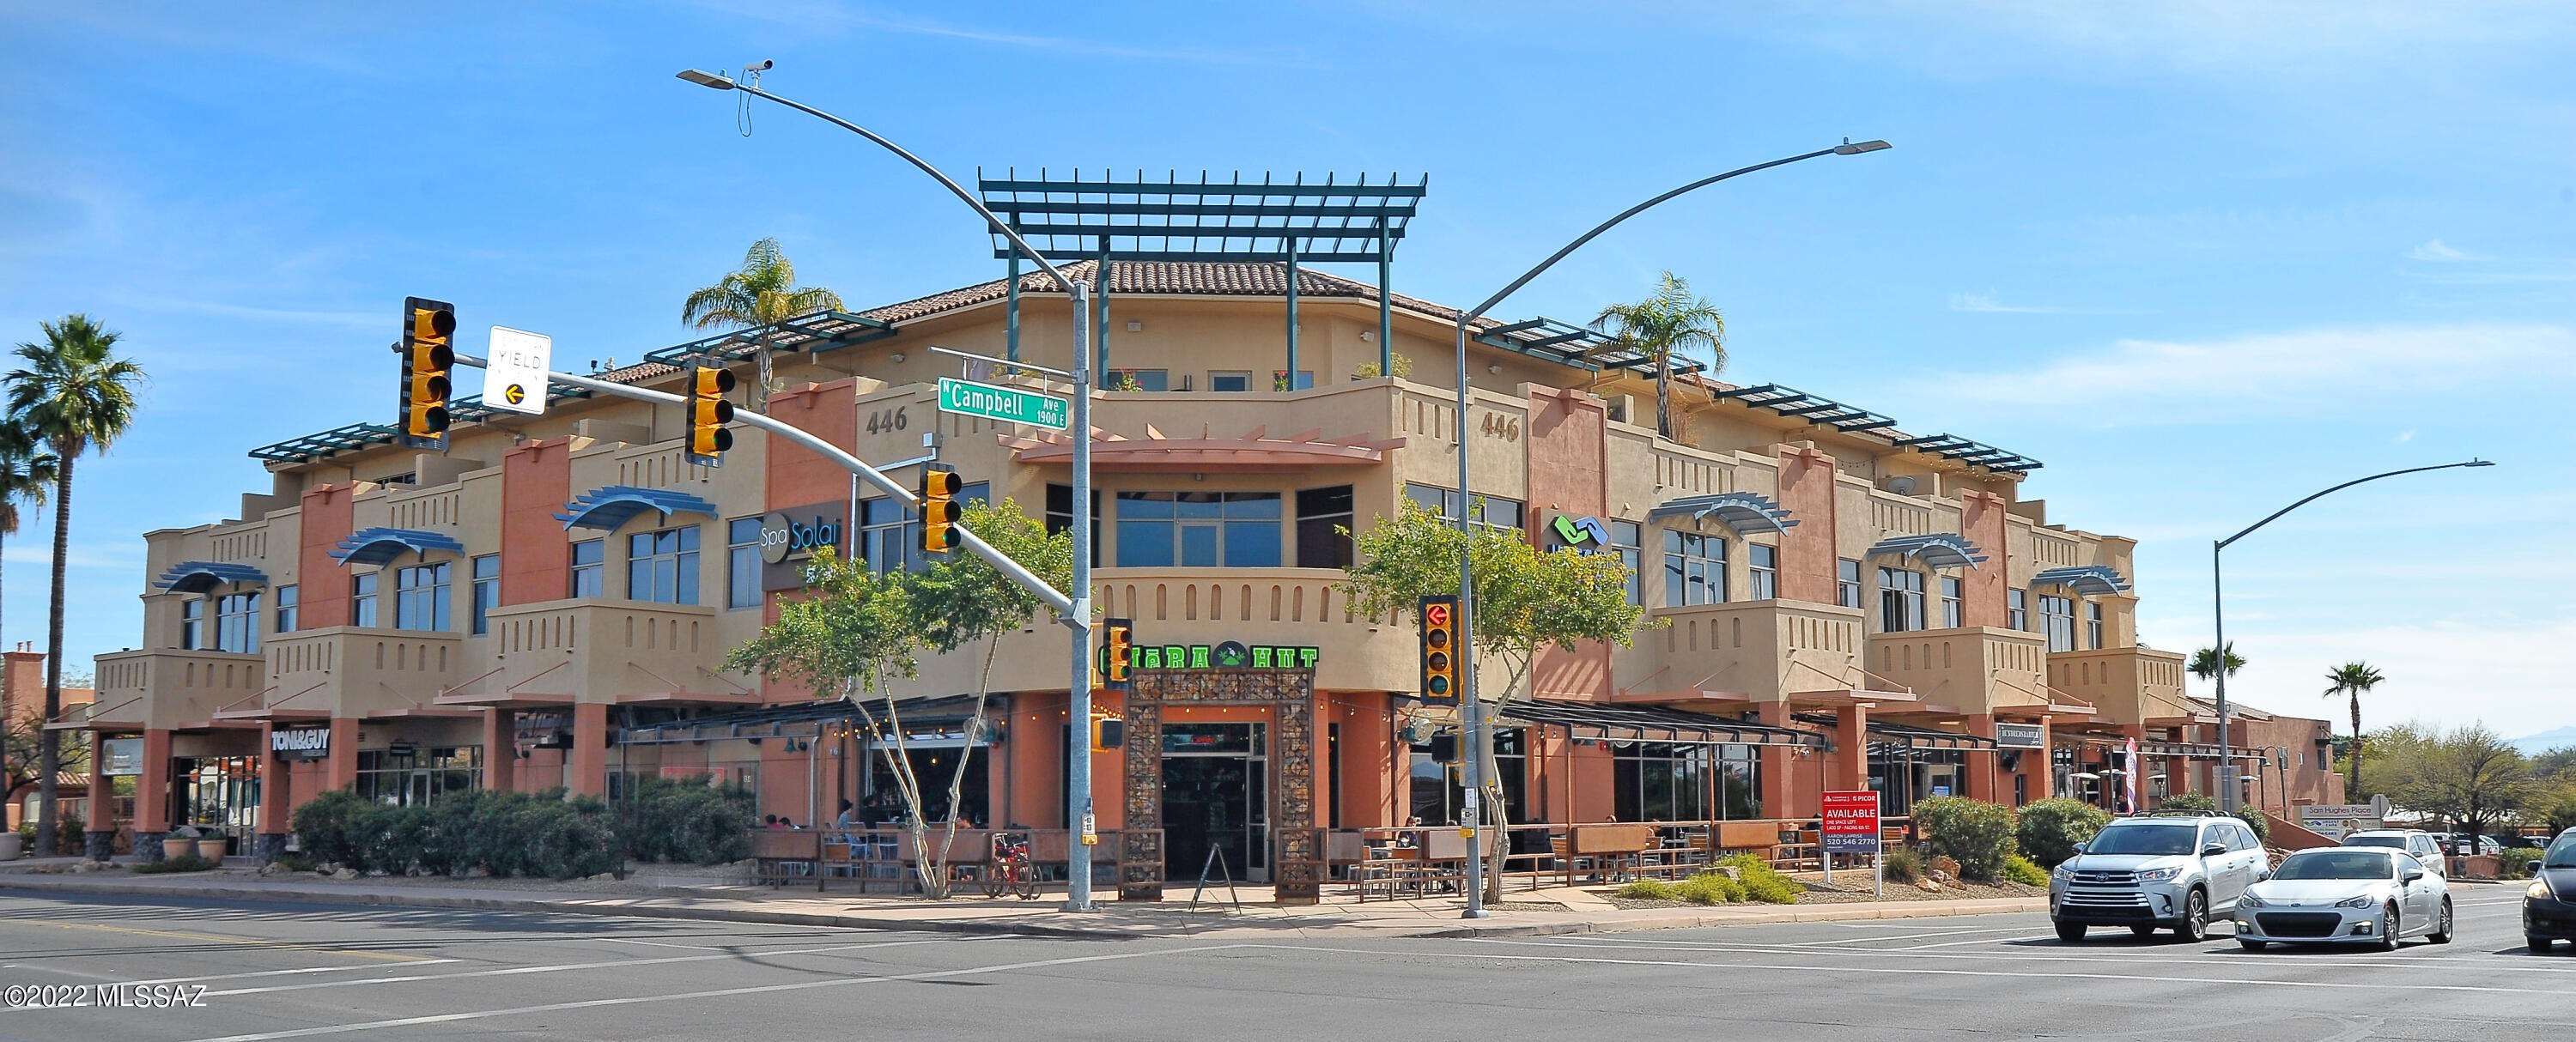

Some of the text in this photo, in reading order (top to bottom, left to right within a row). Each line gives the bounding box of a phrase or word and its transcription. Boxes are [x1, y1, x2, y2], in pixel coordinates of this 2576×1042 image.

[498, 349, 541, 370] YIELD
[943, 380, 1059, 416] N Campbell Ave
[866, 405, 907, 435] 446
[1036, 410, 1065, 427] 1900 E
[1480, 411, 1519, 443] 446
[761, 527, 787, 551] Spa
[1252, 645, 1319, 669] HUT
[271, 729, 331, 751] TONI&GUY
[1827, 809, 1876, 818] AVAILABLE
